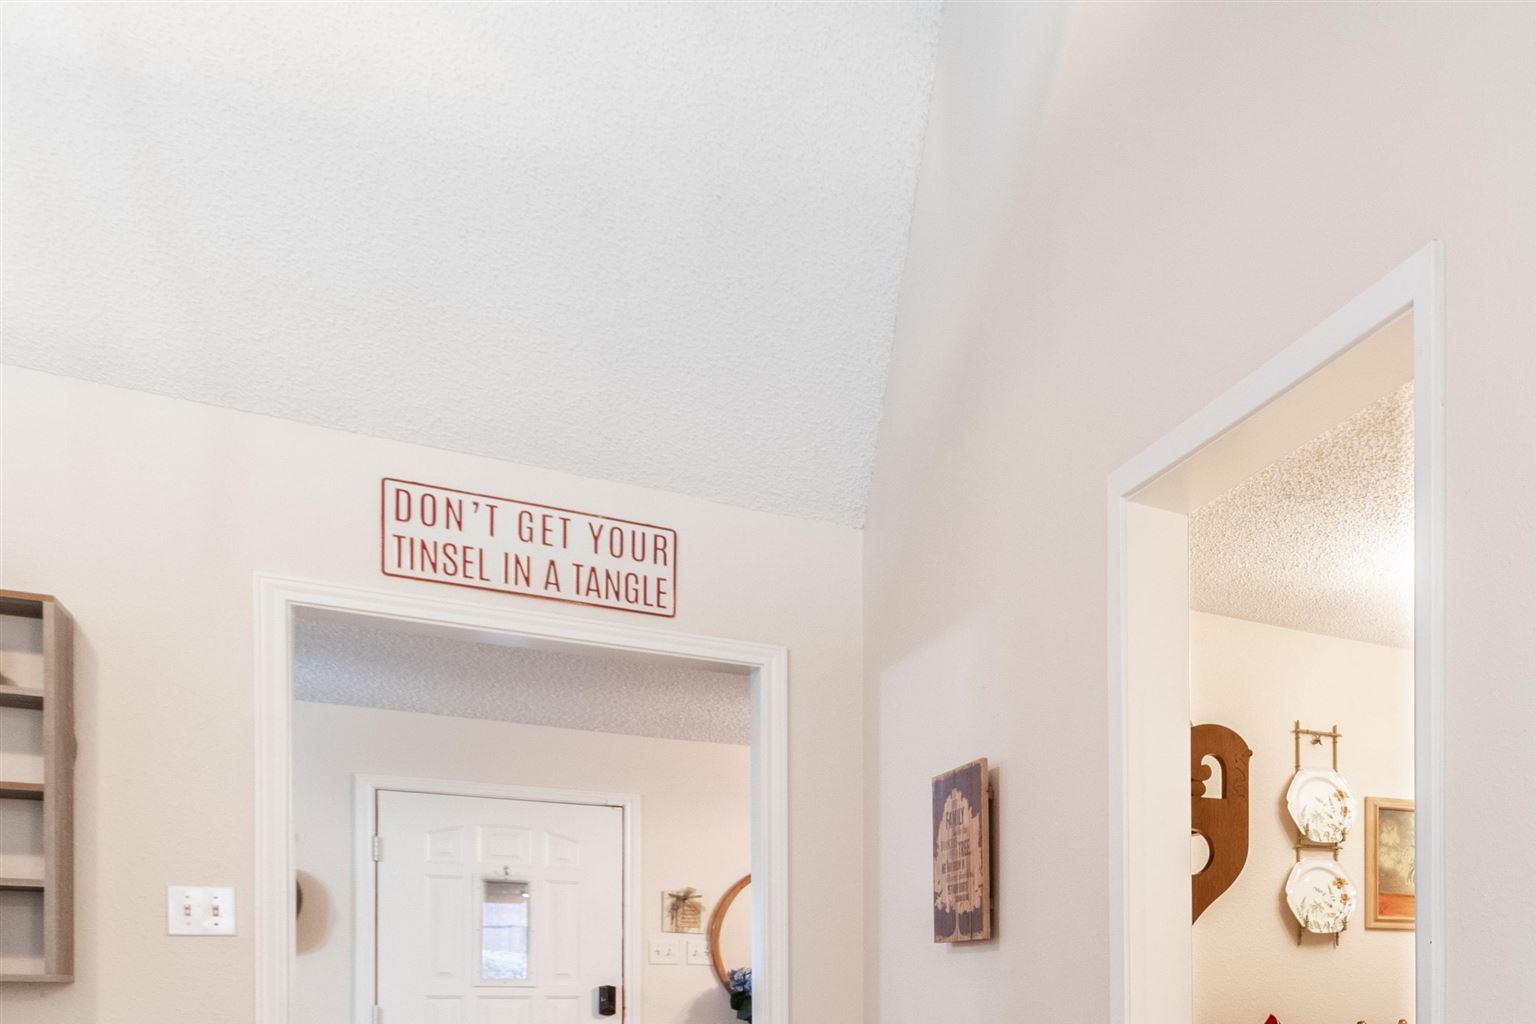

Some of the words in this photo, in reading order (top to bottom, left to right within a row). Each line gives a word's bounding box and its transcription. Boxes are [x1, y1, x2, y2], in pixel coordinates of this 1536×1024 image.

[395, 488, 498, 537] DON'T
[518, 510, 571, 549] GET
[588, 521, 668, 566] YOUR
[392, 534, 491, 582] TINSEL
[504, 552, 530, 588] IN
[544, 559, 561, 592] A
[572, 562, 667, 609] TANGLE
